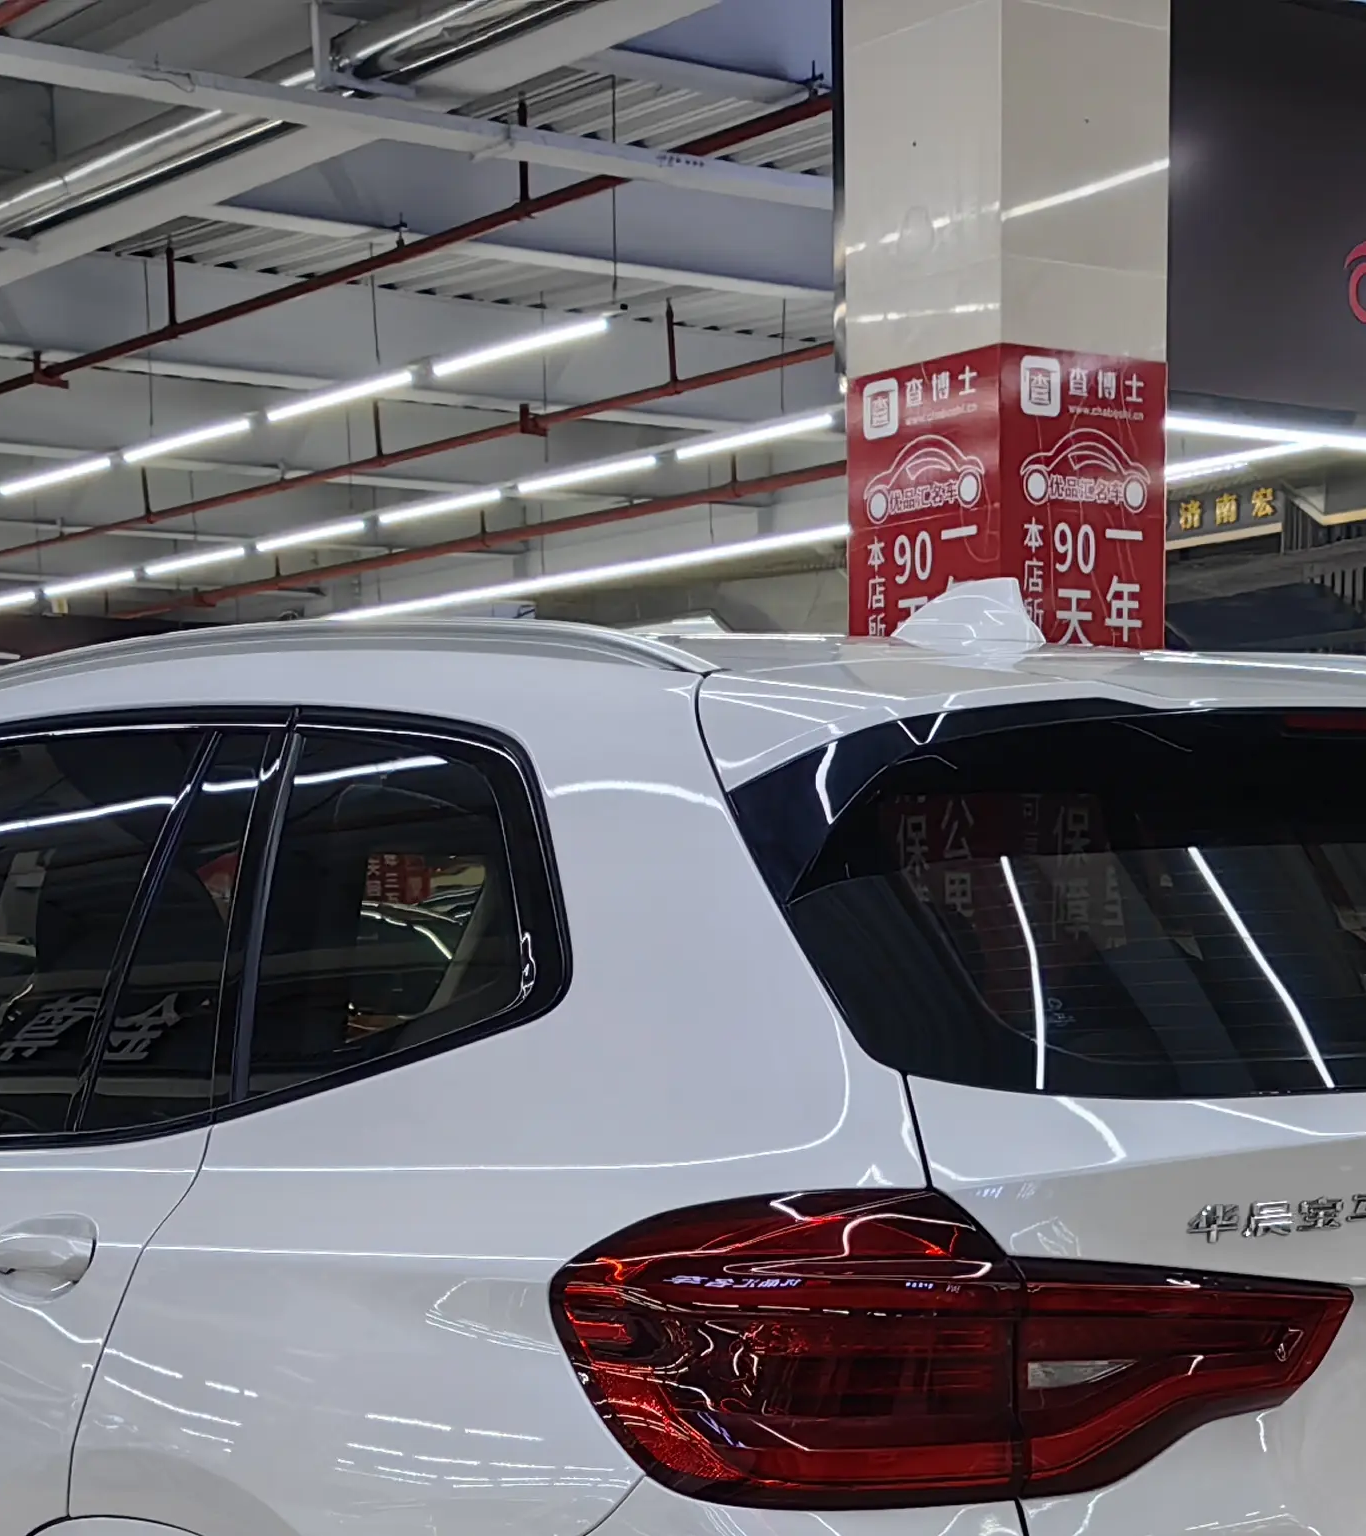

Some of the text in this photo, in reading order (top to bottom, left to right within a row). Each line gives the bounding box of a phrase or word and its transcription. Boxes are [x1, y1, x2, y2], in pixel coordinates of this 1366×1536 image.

[905, 365, 978, 408] 查博士
[1068, 366, 1145, 403] 查博士
[888, 478, 959, 516] 优品汇名车
[1048, 474, 1125, 505] 优品汇名车
[1054, 522, 1096, 646] 90天
[1105, 528, 1144, 643] 一年
